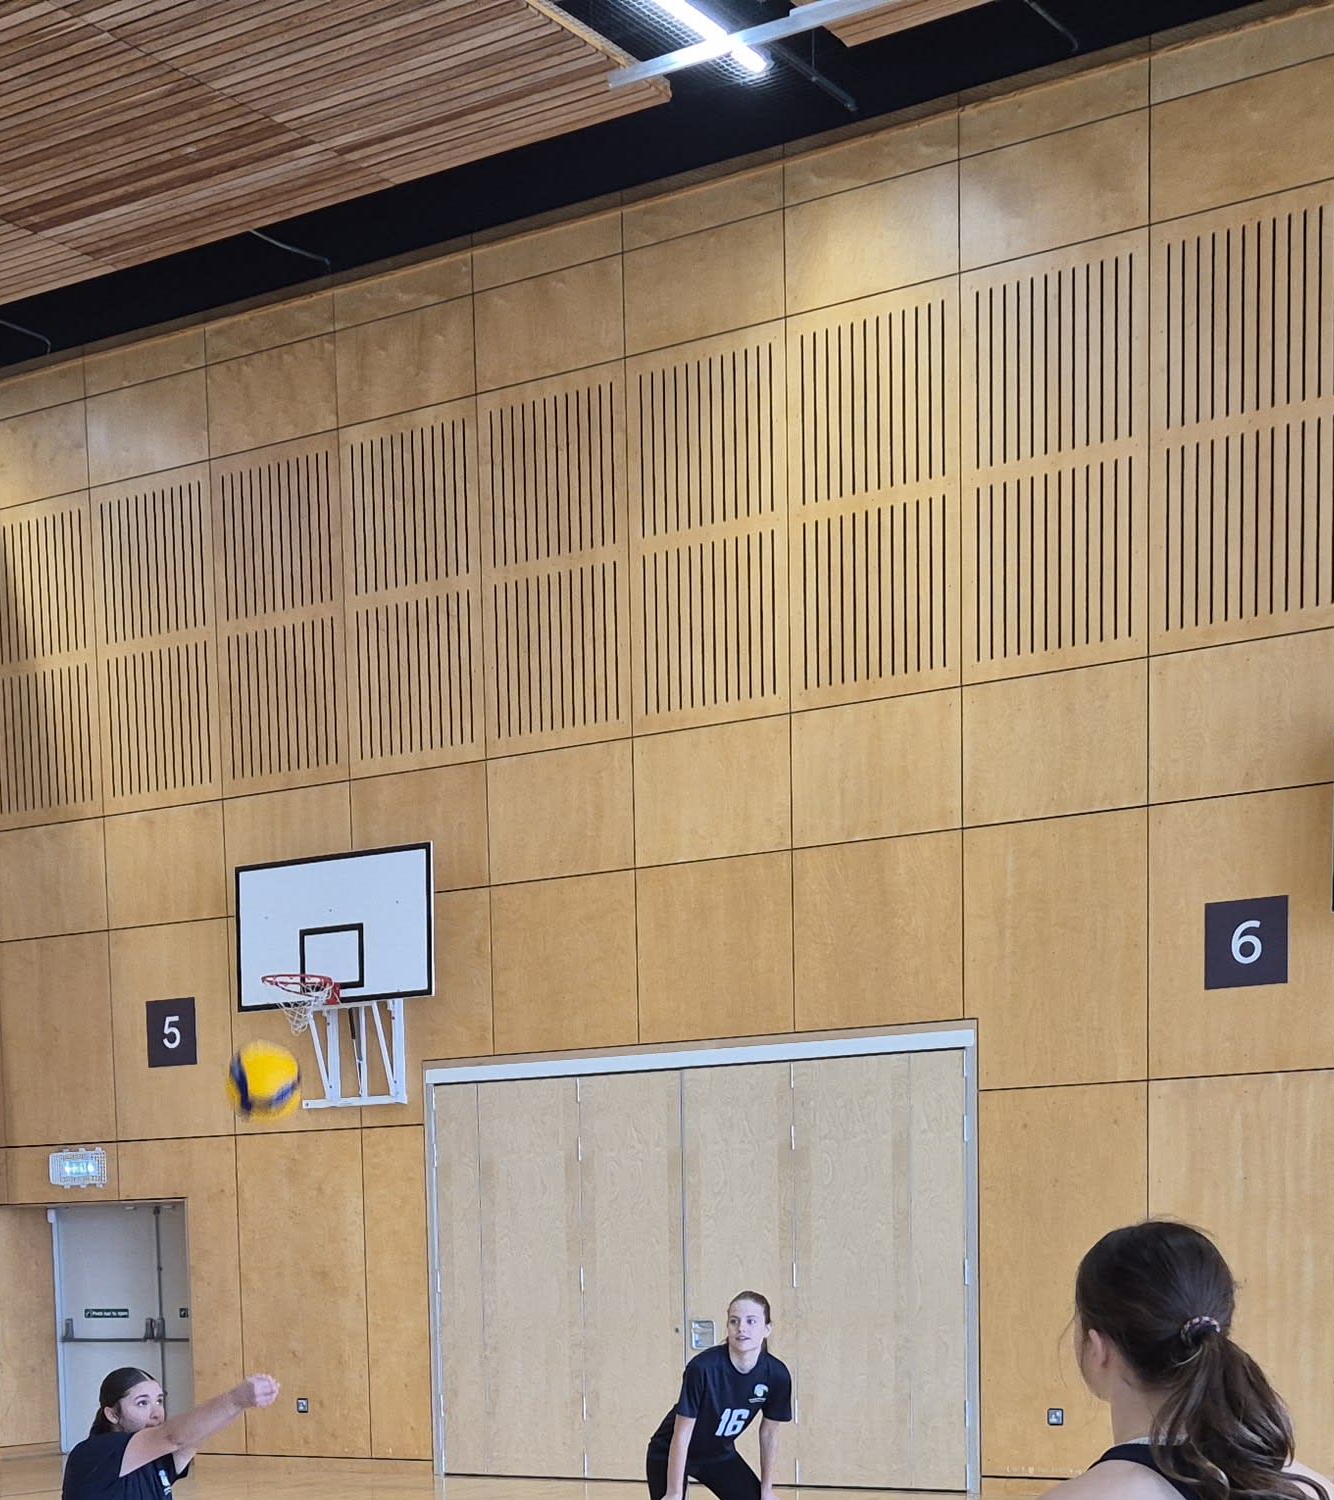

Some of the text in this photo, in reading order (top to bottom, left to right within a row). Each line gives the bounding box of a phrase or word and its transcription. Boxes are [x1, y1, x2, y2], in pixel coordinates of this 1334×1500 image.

[1231, 920, 1262, 965] 6
[162, 1015, 181, 1049] 5
[715, 1408, 750, 1437] 16
